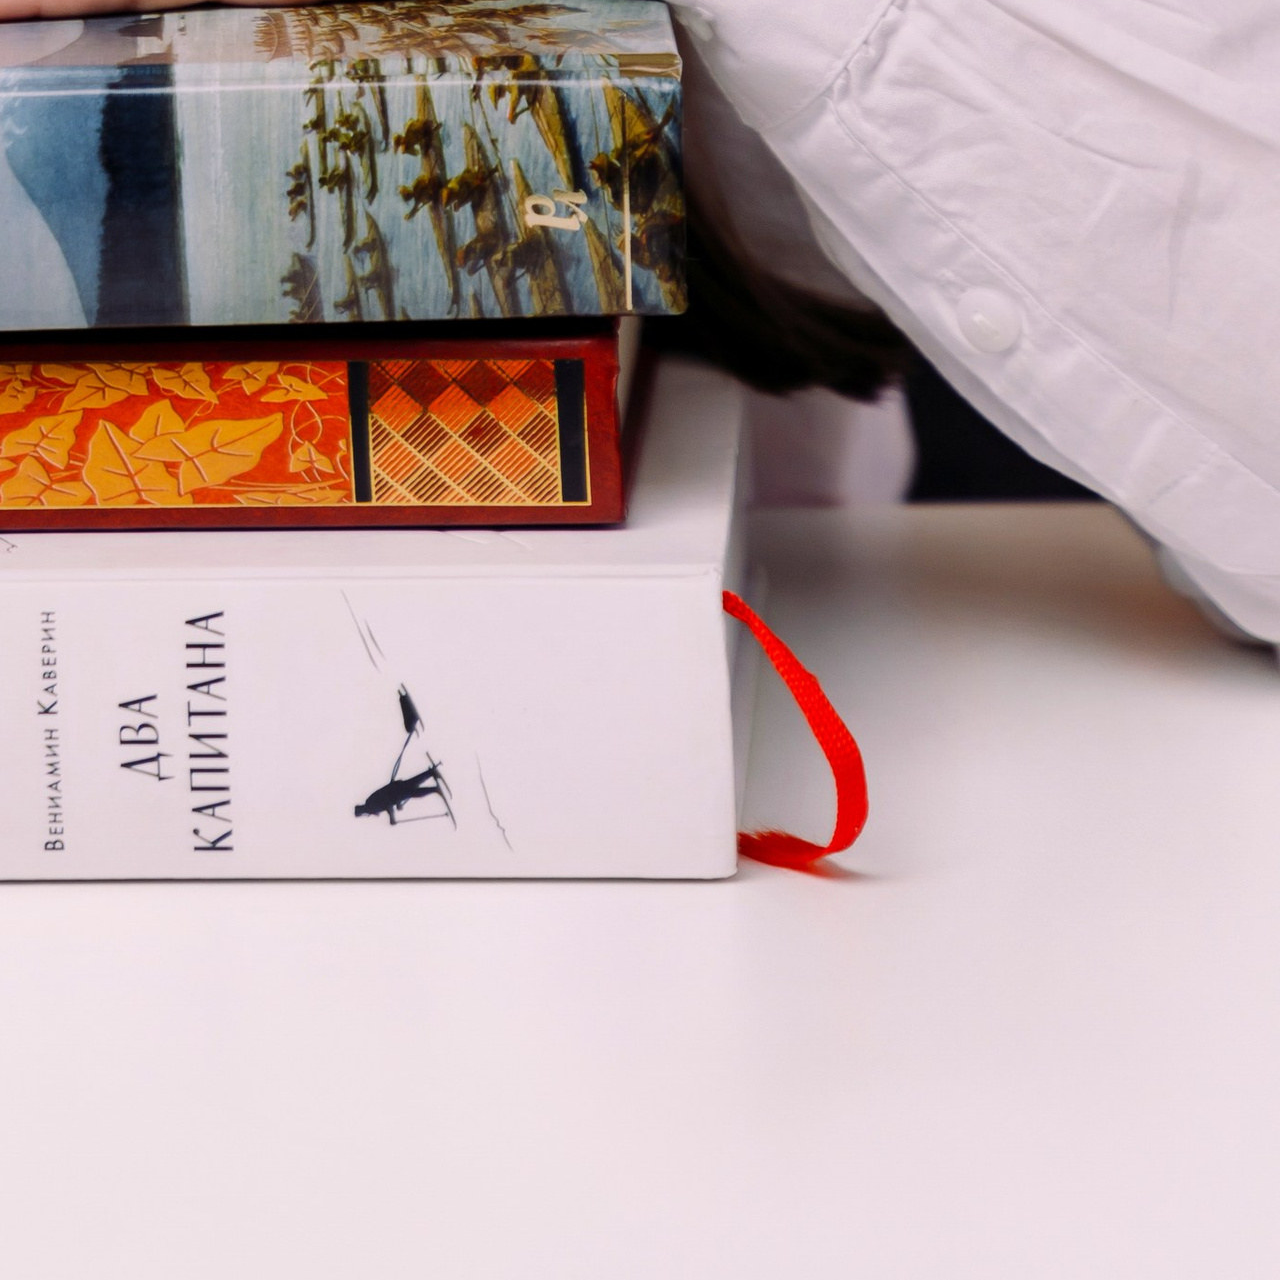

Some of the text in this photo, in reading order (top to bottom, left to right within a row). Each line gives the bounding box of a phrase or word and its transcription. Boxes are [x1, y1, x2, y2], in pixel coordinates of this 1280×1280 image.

[37, 611, 65, 851] ВЕНИАМИН КАВЕРИН
[118, 693, 176, 781] ДВА
[185, 610, 234, 852] КАПИТАНА
